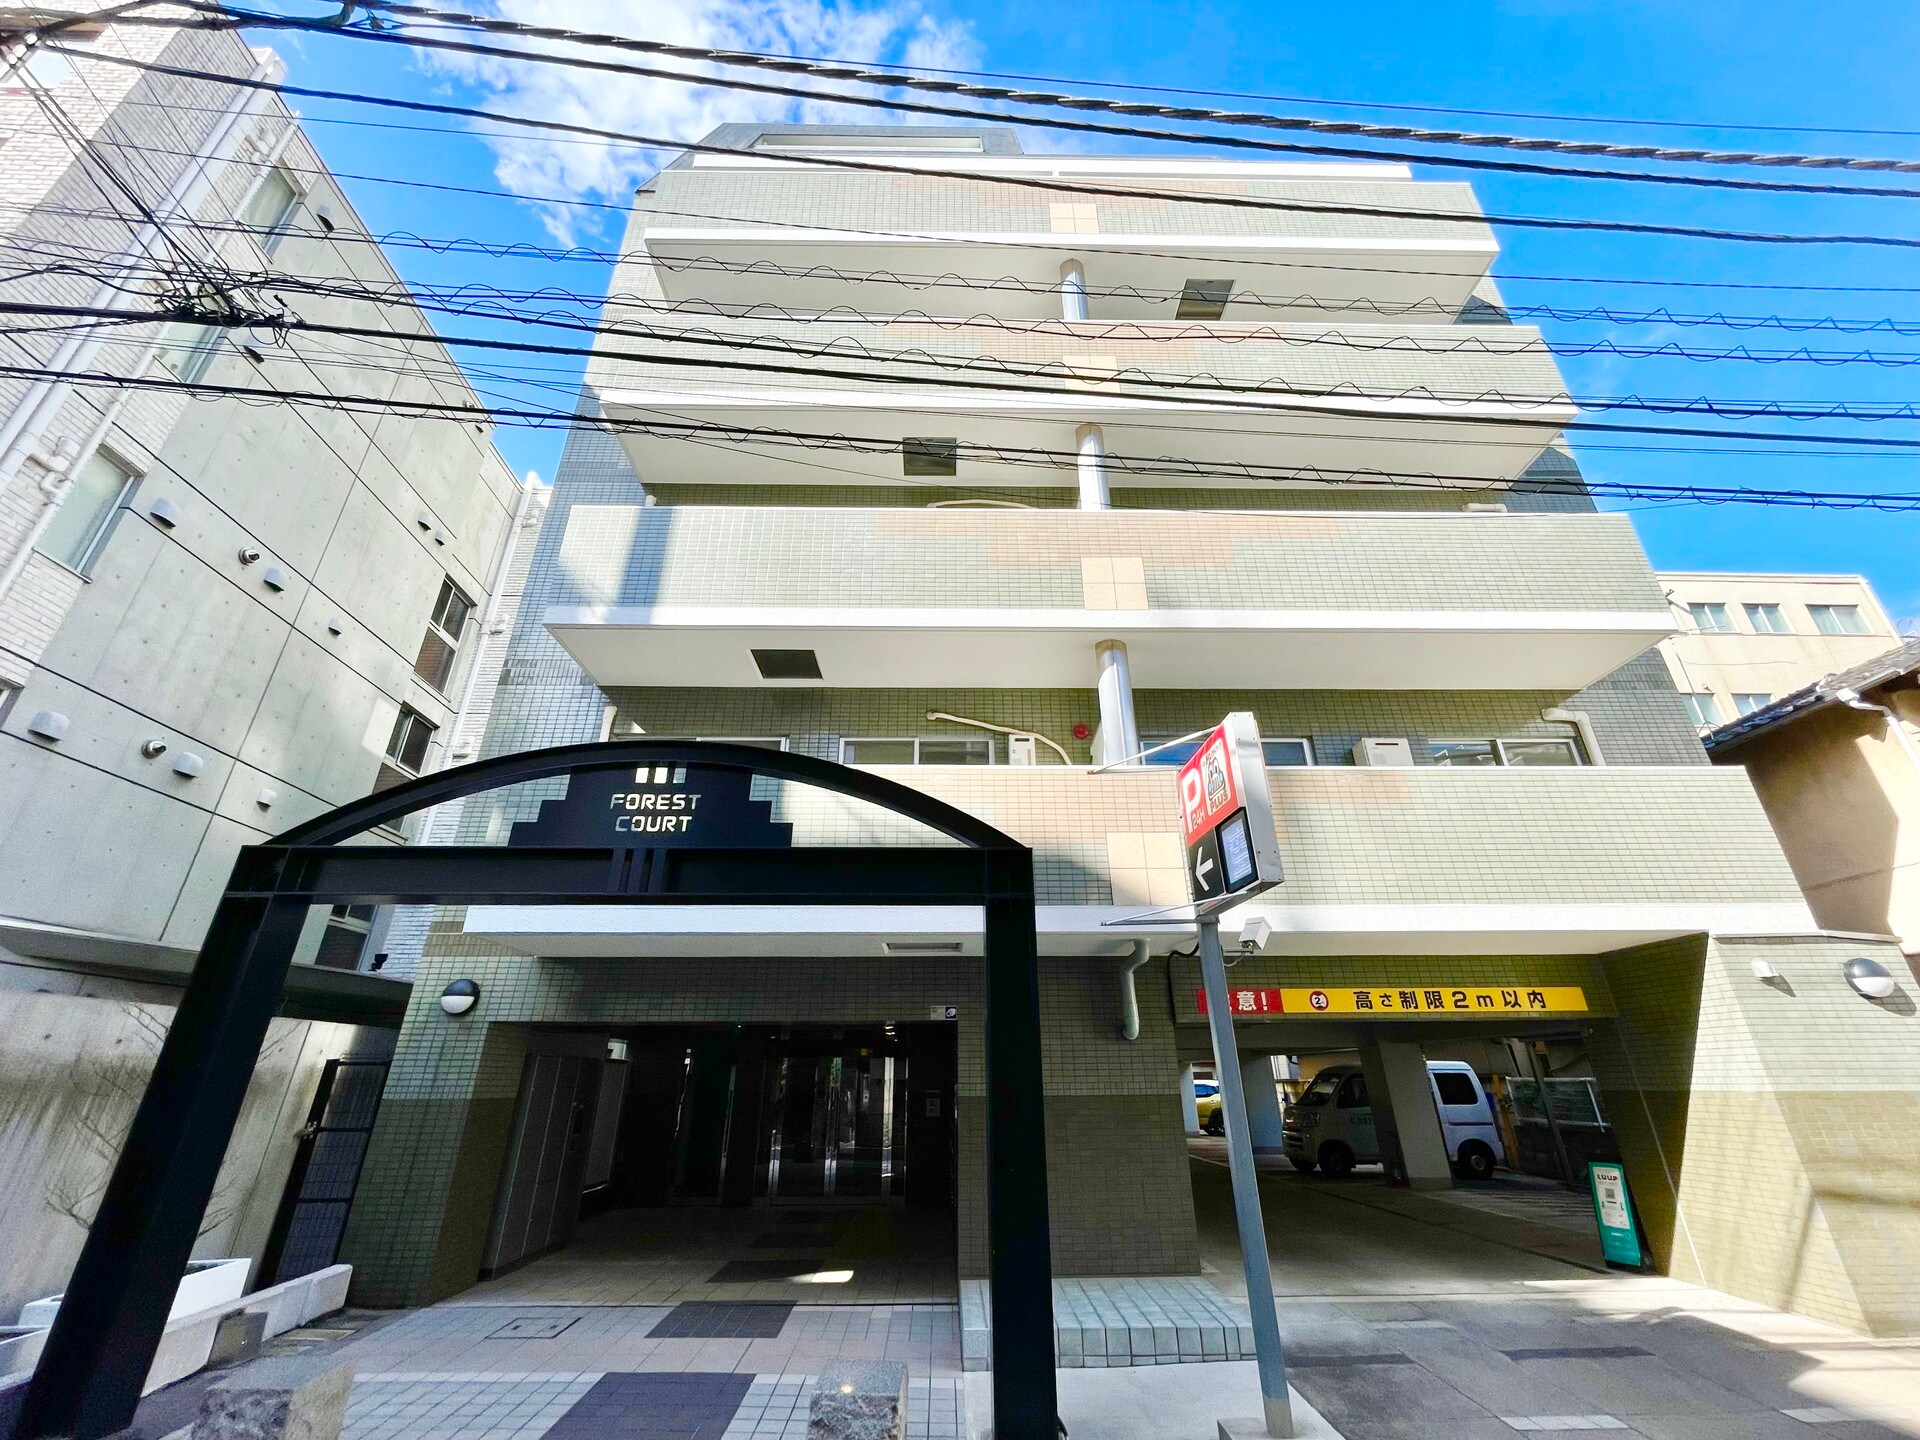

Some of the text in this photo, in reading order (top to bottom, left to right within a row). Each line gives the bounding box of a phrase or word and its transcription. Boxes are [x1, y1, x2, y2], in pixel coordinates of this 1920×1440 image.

[609, 793, 702, 810] FOREST
[1182, 768, 1201, 833] P
[1210, 790, 1228, 812] PLUS
[615, 815, 693, 832] COURT
[1191, 806, 1206, 829] 24H
[1228, 990, 1268, 1011] 意!
